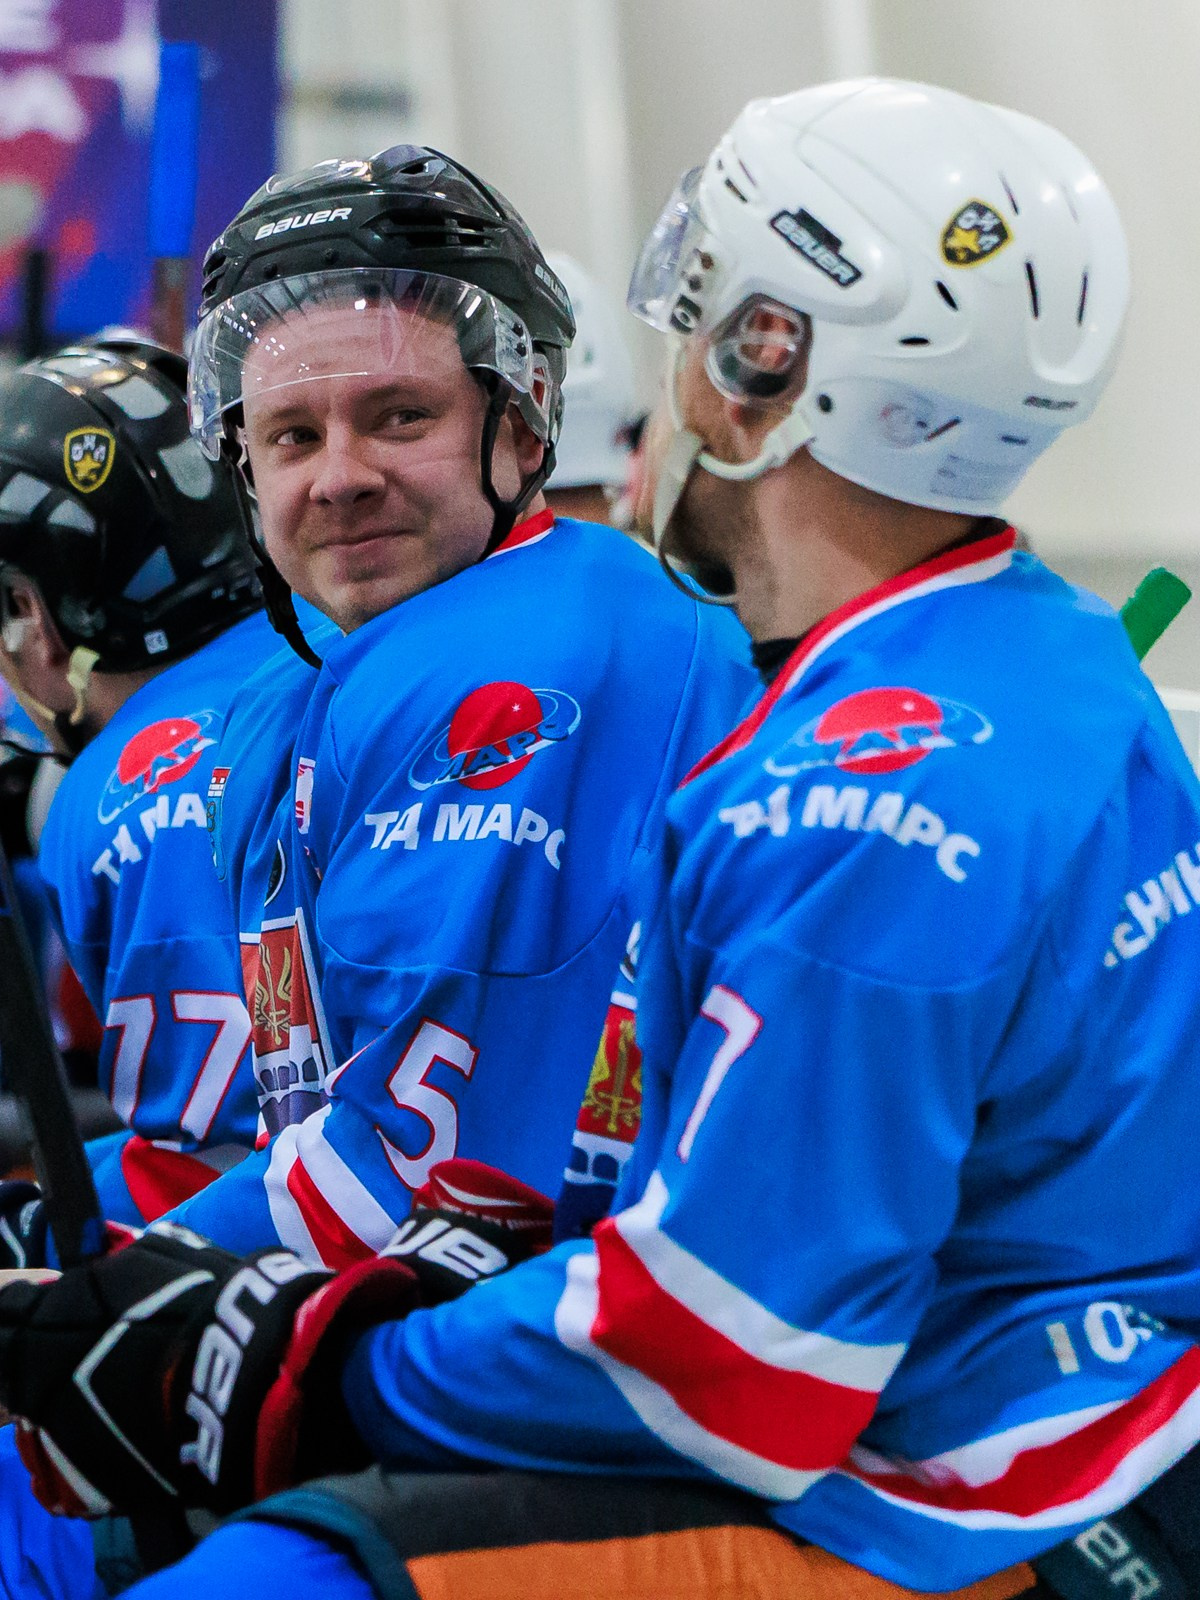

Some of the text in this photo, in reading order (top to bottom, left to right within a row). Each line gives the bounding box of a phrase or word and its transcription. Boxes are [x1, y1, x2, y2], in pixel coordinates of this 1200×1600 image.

[254, 207, 353, 241] BAUER
[773, 214, 856, 284] BAUER
[801, 785, 980, 882] МАРС
[103, 990, 254, 1142] 17
